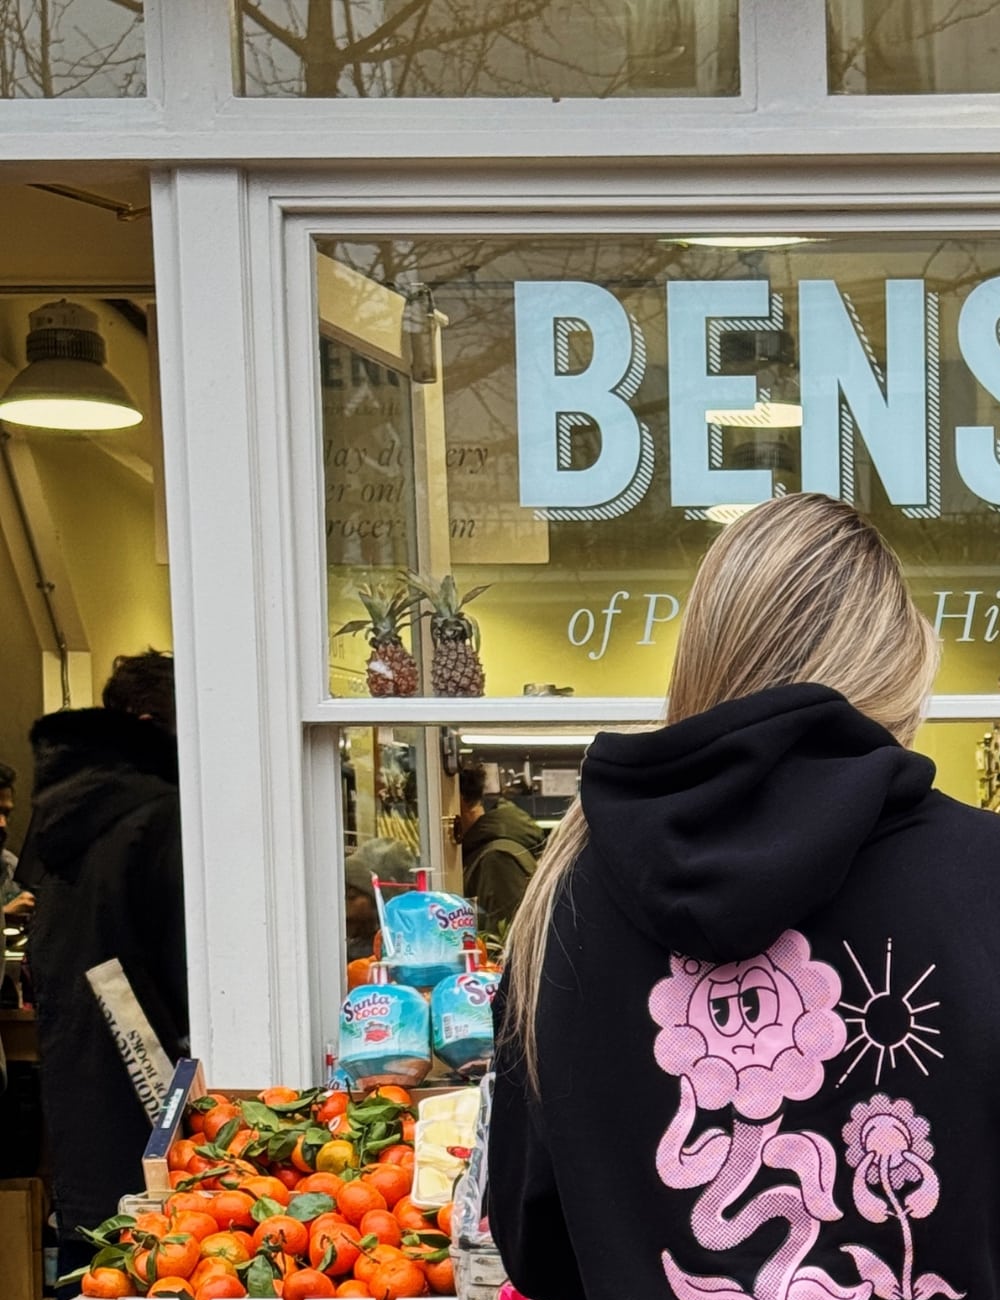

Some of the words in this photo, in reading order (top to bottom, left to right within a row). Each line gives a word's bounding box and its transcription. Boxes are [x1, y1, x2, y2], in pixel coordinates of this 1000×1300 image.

[567, 590, 629, 661] of
[343, 993, 391, 1022] Santa
[127, 1029, 157, 1079] BOOKS
